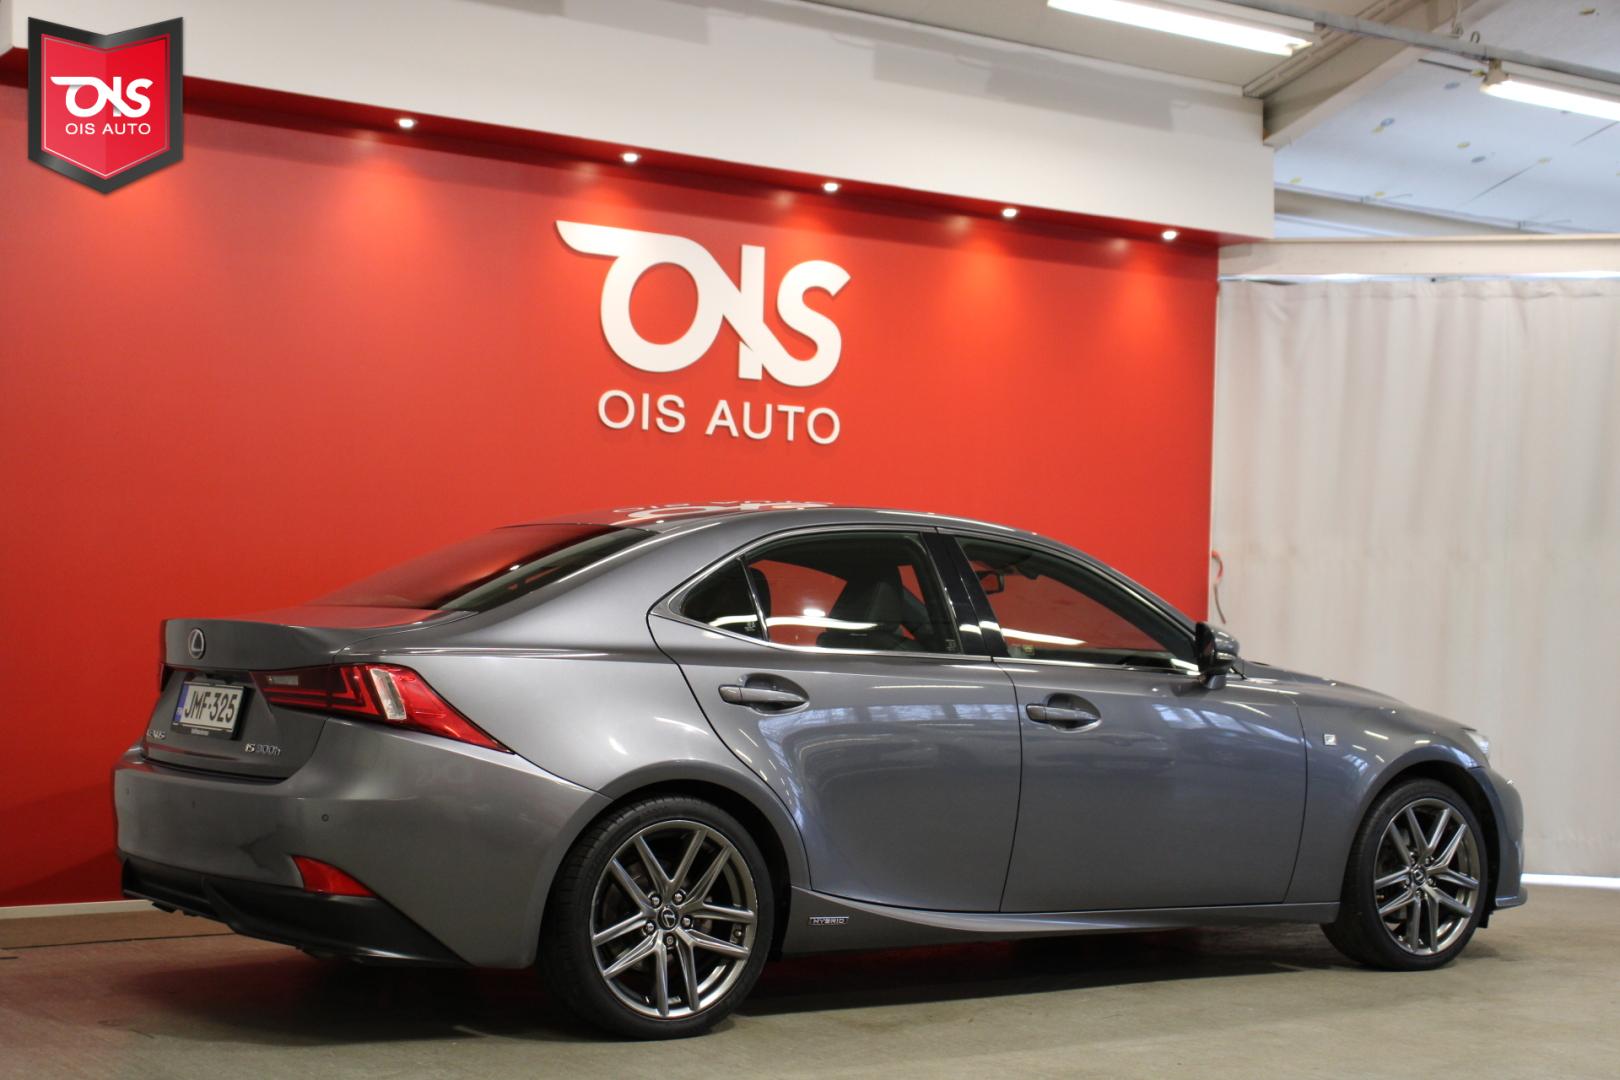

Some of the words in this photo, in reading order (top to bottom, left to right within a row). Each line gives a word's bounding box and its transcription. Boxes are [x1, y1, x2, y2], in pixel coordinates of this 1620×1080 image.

[597, 389, 687, 434] OIS
[704, 399, 841, 445] AUTO
[184, 690, 238, 723] JMF-325
[811, 917, 847, 925] HYBRID
